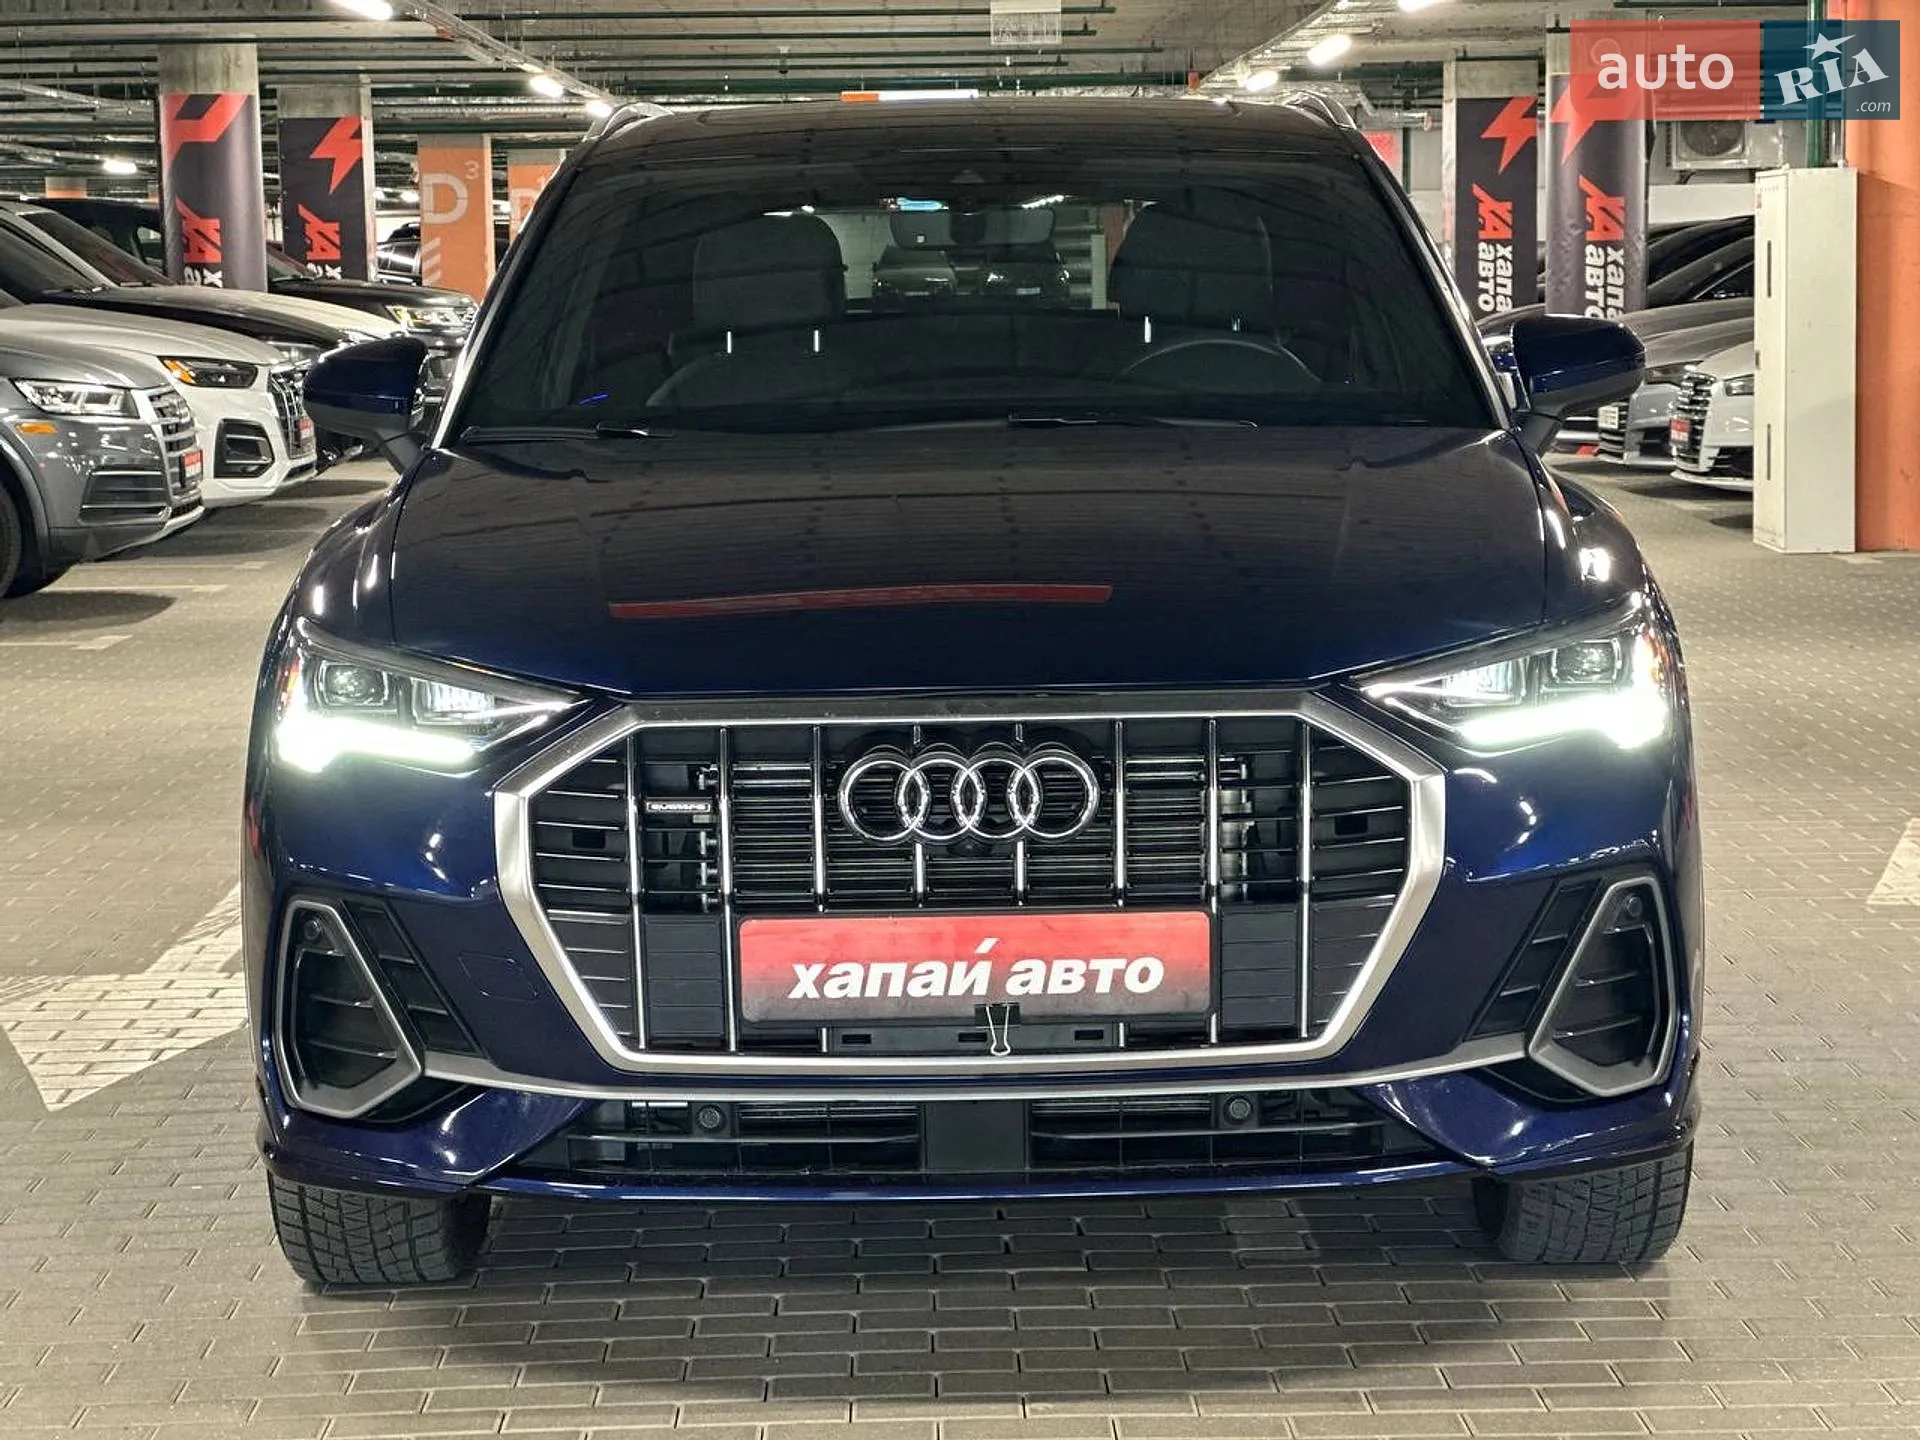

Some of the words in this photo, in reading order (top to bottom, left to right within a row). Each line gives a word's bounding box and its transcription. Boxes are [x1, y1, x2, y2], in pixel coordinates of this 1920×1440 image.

[1478, 241, 1494, 312] авто
[788, 937, 999, 999] хапай
[1005, 957, 1164, 996] авто
